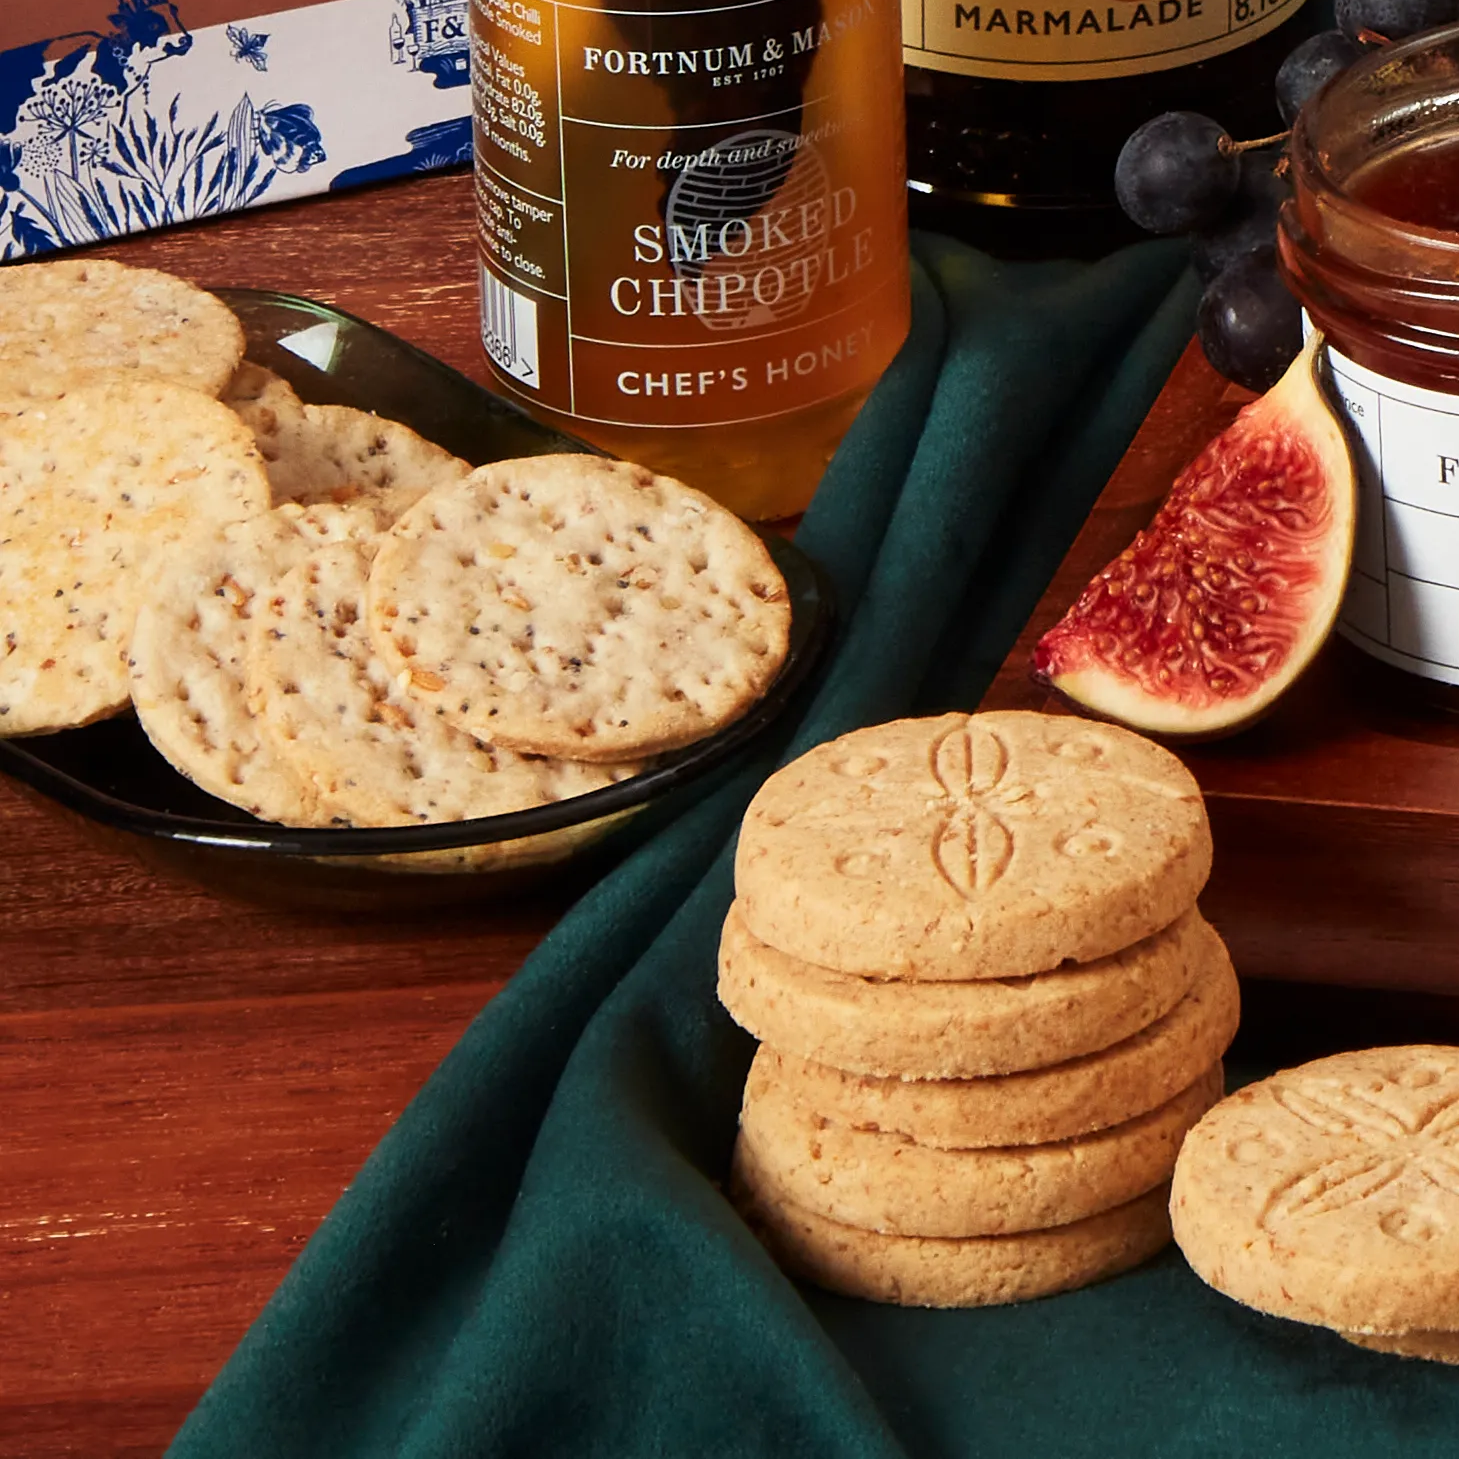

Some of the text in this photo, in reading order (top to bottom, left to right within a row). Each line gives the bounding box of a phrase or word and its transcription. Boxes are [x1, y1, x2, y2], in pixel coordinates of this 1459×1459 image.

[496, 11, 542, 46] Smoked
[583, 43, 754, 75] FORTNUM
[762, 38, 784, 62] &
[712, 64, 785, 87] EST 1707
[610, 150, 720, 172] For depth
[511, 195, 553, 223] tamper
[634, 185, 859, 265] SMOKED
[514, 254, 546, 279] close.
[609, 227, 876, 319] CHIPOTLE
[765, 320, 877, 386] HONEY
